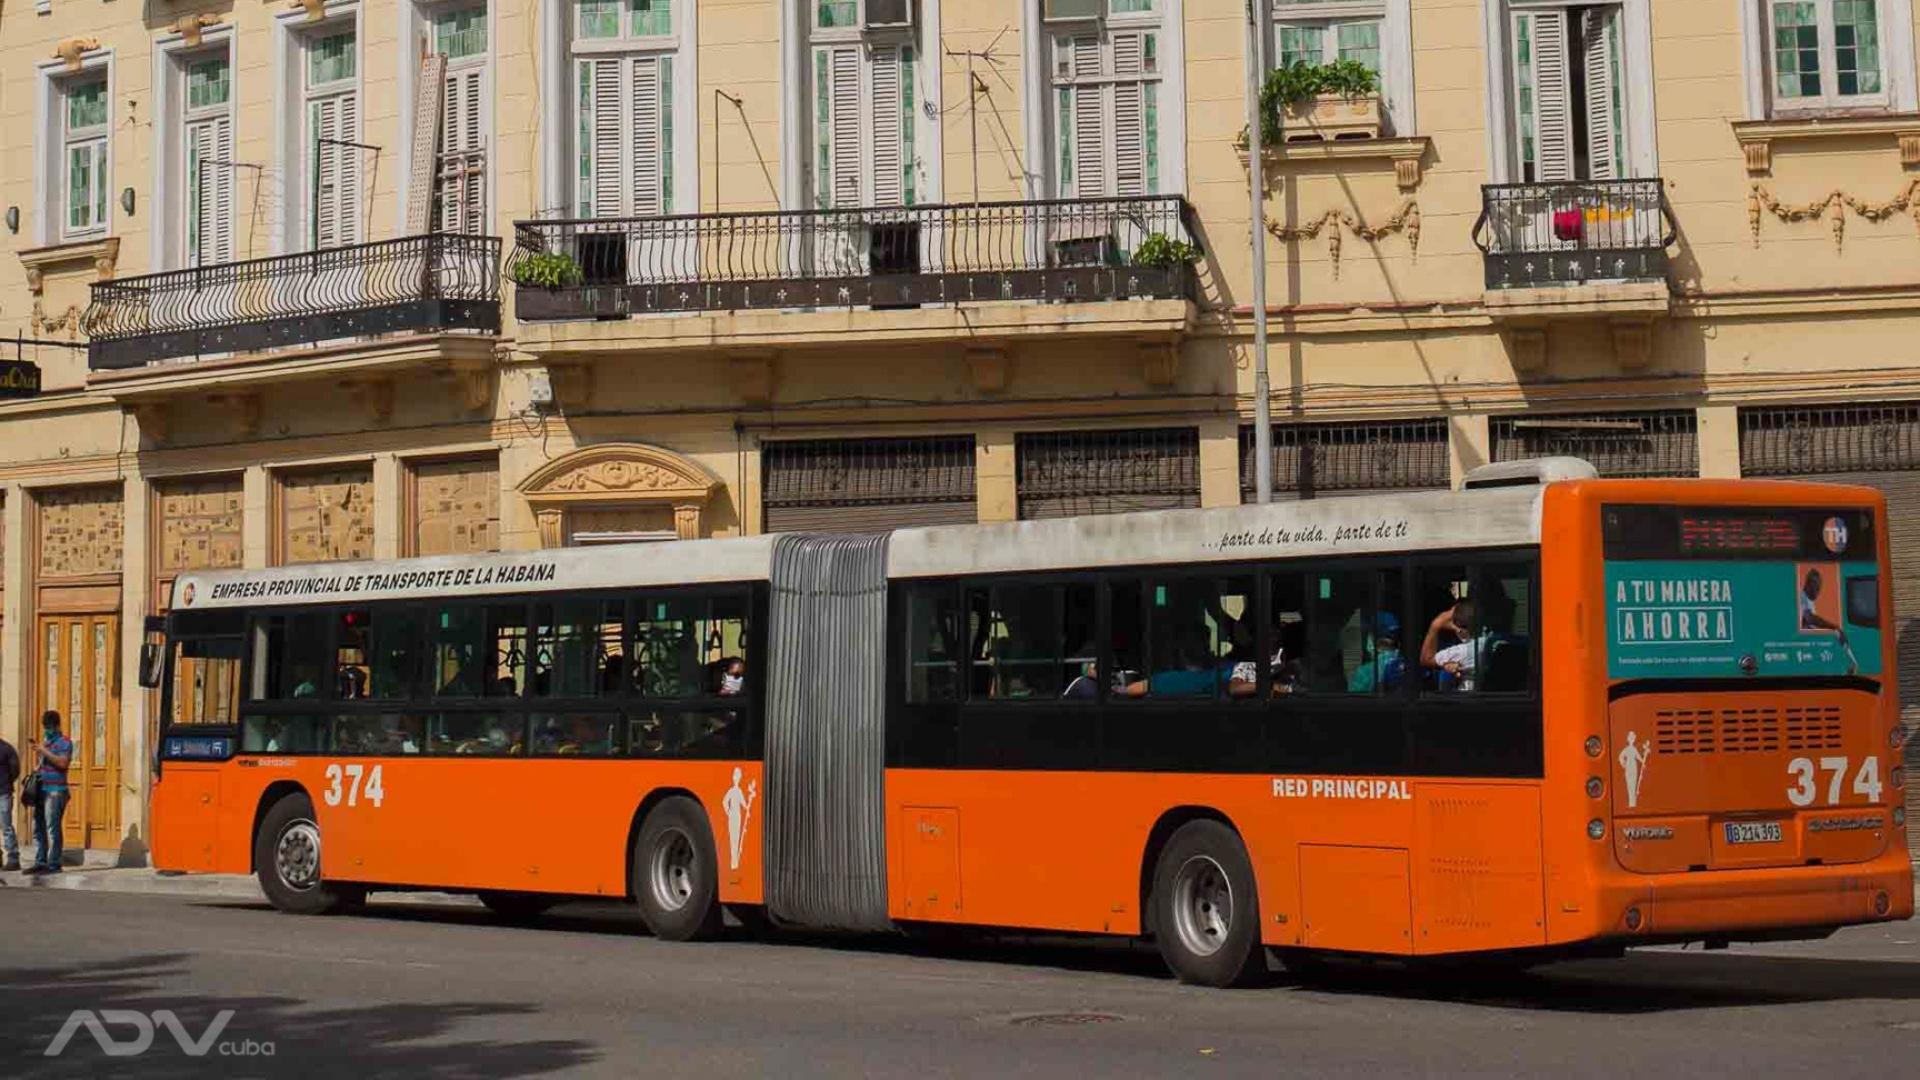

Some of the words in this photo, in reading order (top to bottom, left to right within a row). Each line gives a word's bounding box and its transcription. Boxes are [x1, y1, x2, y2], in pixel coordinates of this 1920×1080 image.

[1258, 527, 1273, 545] de
[1277, 527, 1290, 544] tu
[1333, 522, 1370, 545] parte
[1375, 520, 1391, 539] de
[1395, 521, 1408, 537] ti
[211, 581, 266, 599] EMPRESA
[267, 576, 341, 596] PROVINCIAL
[344, 575, 363, 592] DE
[364, 570, 453, 591] TRANSPORTE
[454, 569, 474, 586] DE
[475, 567, 492, 584] LA
[495, 563, 556, 583] HABANA
[1617, 580, 1626, 603] A
[1631, 580, 1655, 602] TU
[1661, 579, 1732, 603] MANERA
[1625, 611, 1726, 640] AHORRA
[324, 764, 384, 808] 374
[1272, 779, 1308, 797] RED
[1312, 780, 1411, 799] PRINCIPAL
[1787, 756, 1883, 806] 374
